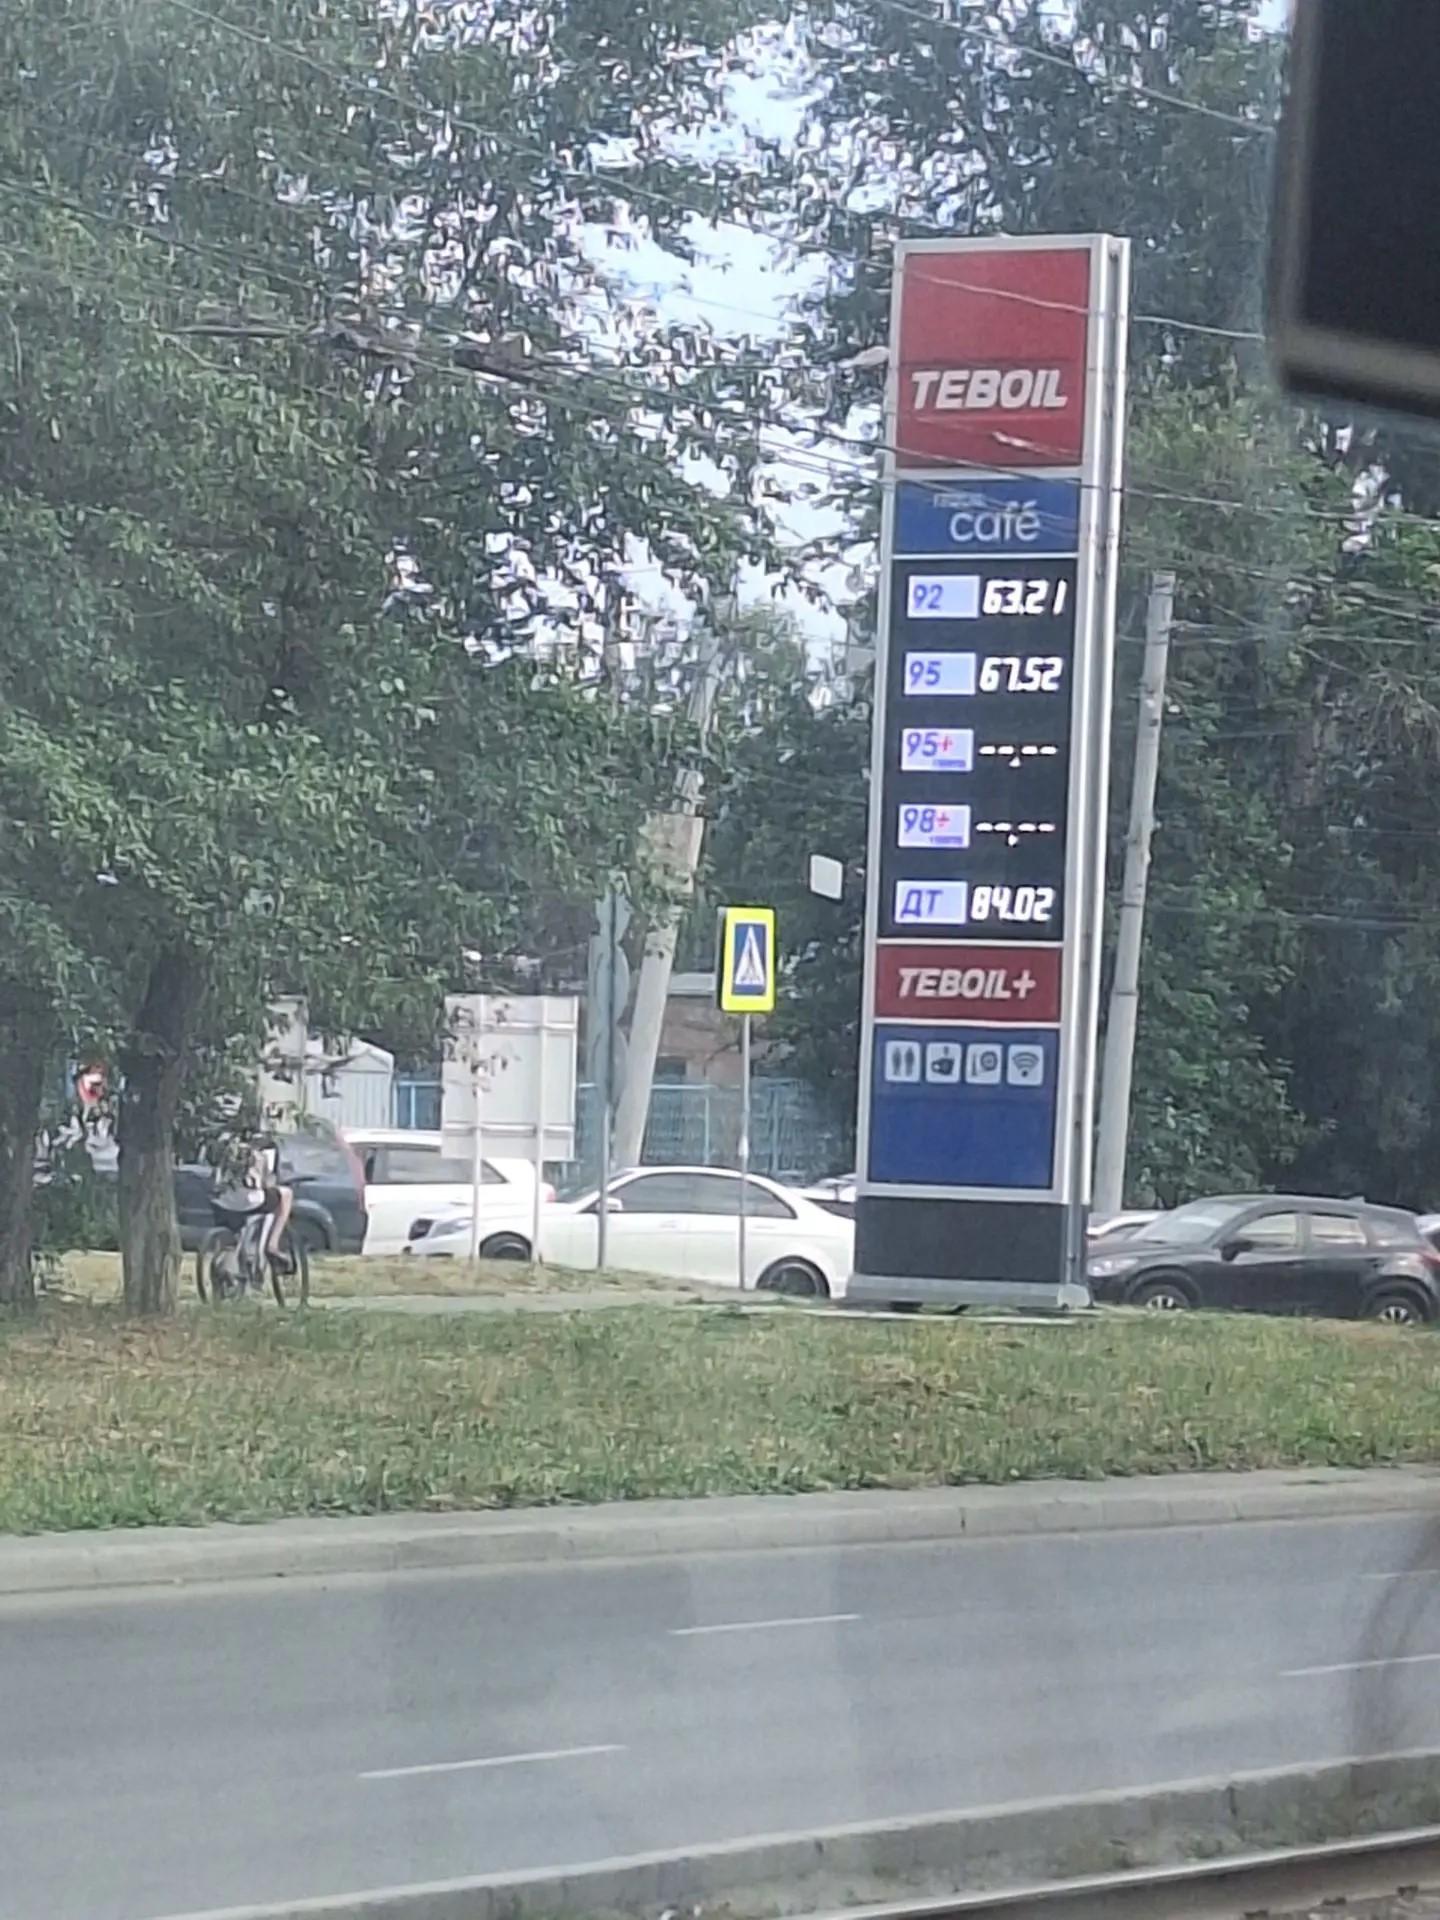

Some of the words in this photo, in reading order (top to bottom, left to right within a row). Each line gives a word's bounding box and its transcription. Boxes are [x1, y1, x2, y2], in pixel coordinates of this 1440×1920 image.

[911, 368, 1068, 410] TEBOIL
[950, 500, 1040, 542] café
[913, 584, 943, 609] 92
[983, 579, 1067, 615] 63.21
[909, 661, 941, 686] 95
[979, 656, 1063, 691] 67.52
[906, 732, 953, 757] 95+
[900, 889, 943, 918] ДТ
[970, 886, 1056, 921] 84.02
[898, 968, 1036, 998] TEBOIL+
